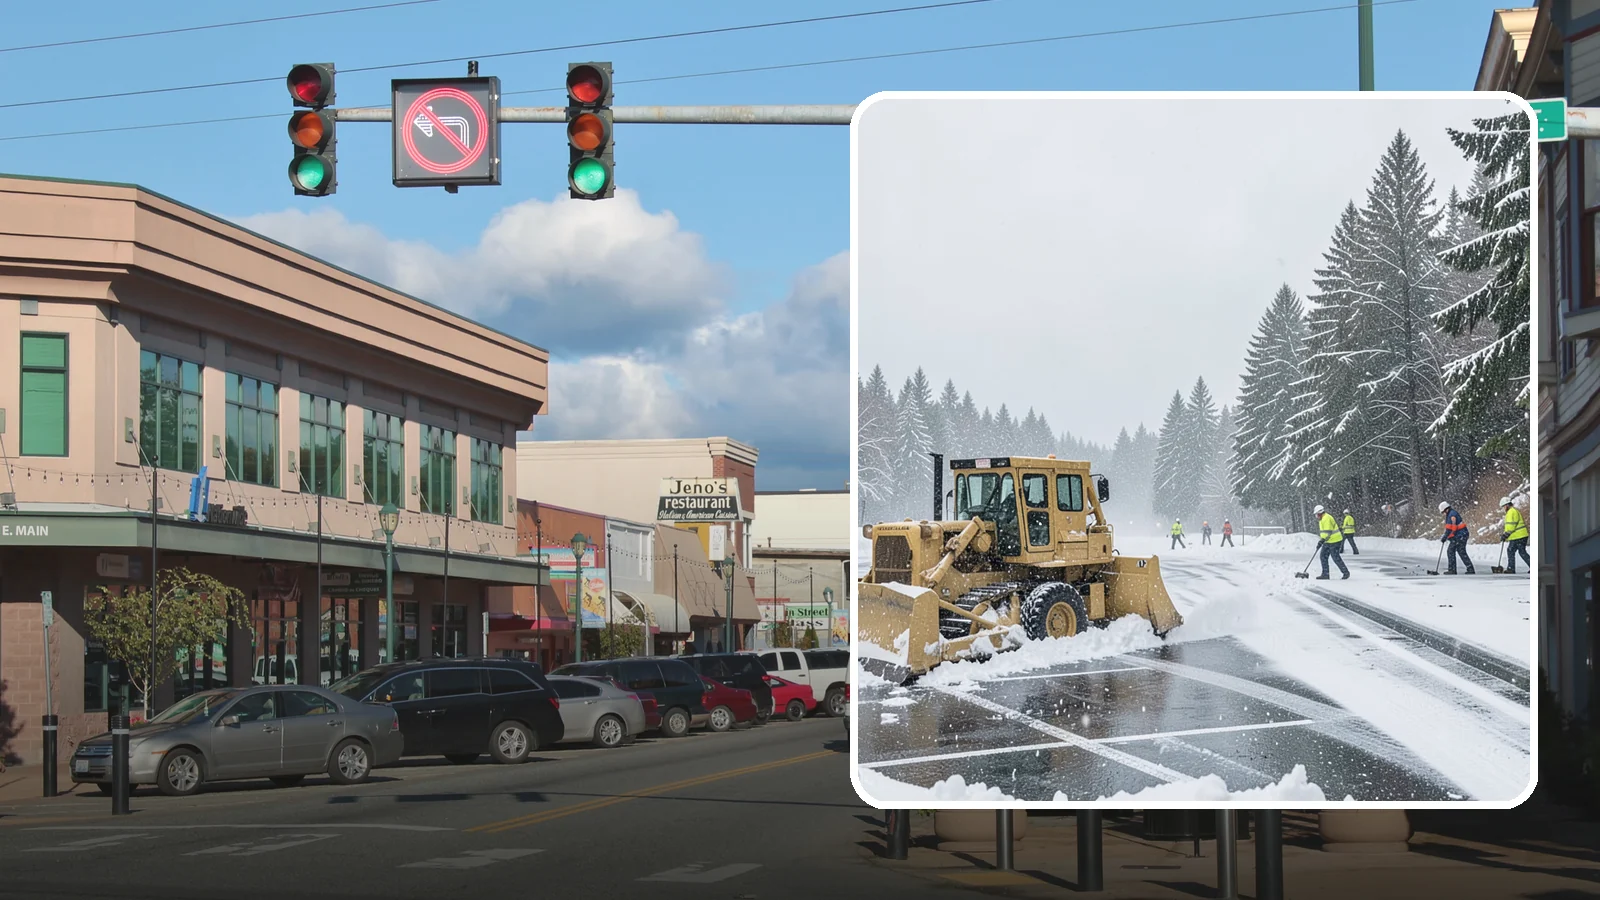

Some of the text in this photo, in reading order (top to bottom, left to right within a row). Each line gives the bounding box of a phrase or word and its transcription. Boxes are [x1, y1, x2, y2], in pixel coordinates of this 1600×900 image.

[669, 479, 728, 495] Jeno's
[665, 496, 731, 509] restaurant
[658, 509, 681, 520] Italian
[686, 509, 714, 520] American
[715, 509, 737, 519] Cuisine
[2, 525, 49, 537] E. MAIN
[797, 607, 828, 617] Street
